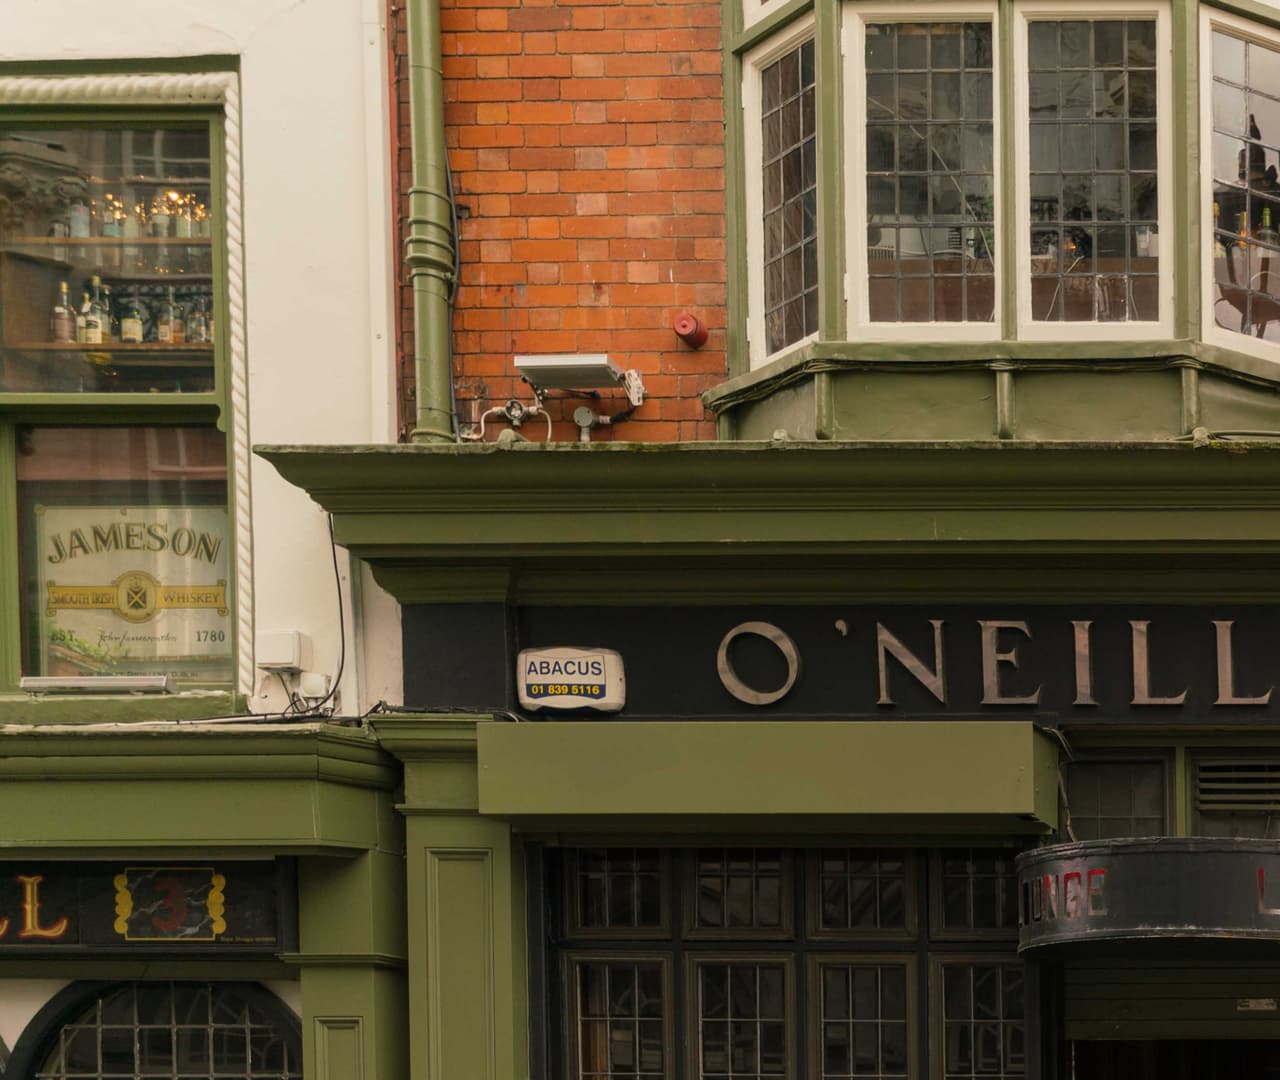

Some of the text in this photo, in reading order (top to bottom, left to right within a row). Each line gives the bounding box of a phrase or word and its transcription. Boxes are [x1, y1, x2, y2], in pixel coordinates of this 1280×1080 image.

[48, 522, 223, 565] JAMESON
[163, 590, 220, 604] WHISKEY
[196, 630, 226, 642] 1780
[527, 661, 602, 675] ABACUS
[716, 618, 1276, 707] O'NEILL
[531, 685, 600, 694] 01 839 5116
[0, 875, 68, 939] L
[151, 877, 190, 932] 3
